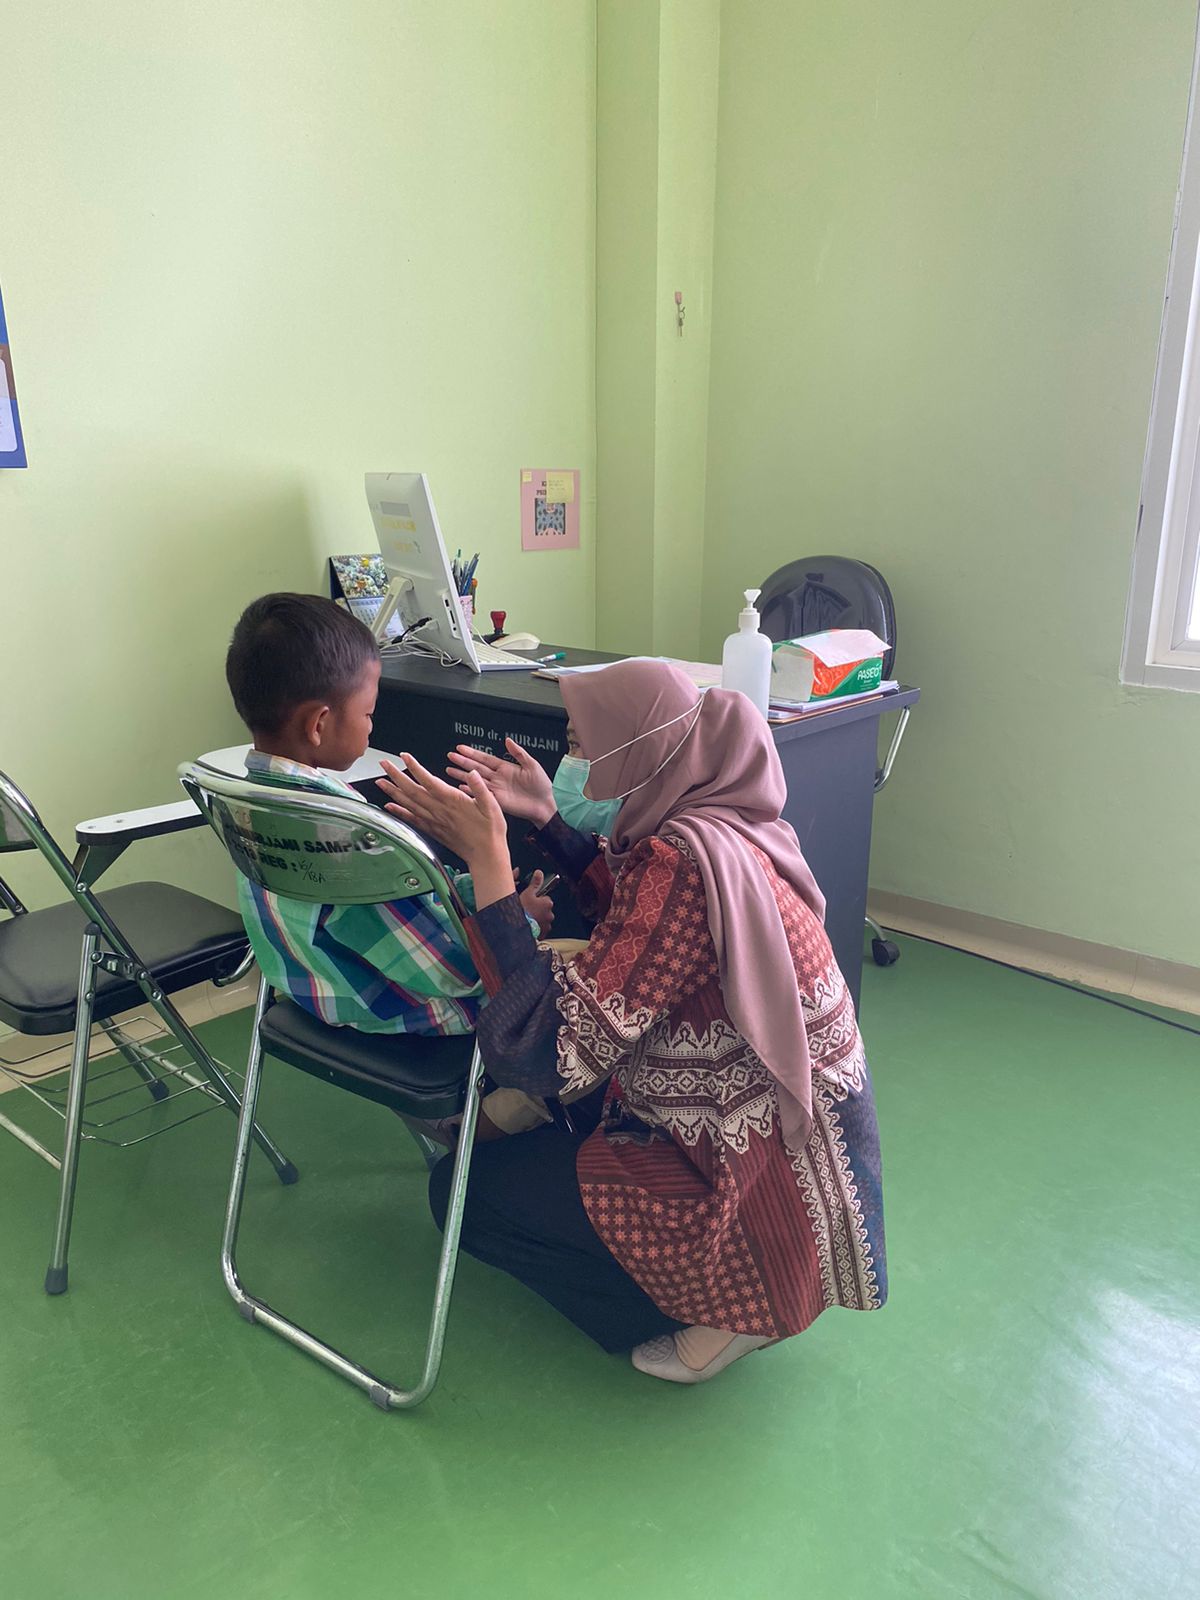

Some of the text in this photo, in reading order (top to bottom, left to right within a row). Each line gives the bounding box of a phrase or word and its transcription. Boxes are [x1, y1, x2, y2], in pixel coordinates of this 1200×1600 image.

[857, 667, 879, 681] PASEO
[454, 721, 485, 738] RSUD
[487, 729, 502, 741] dr.
